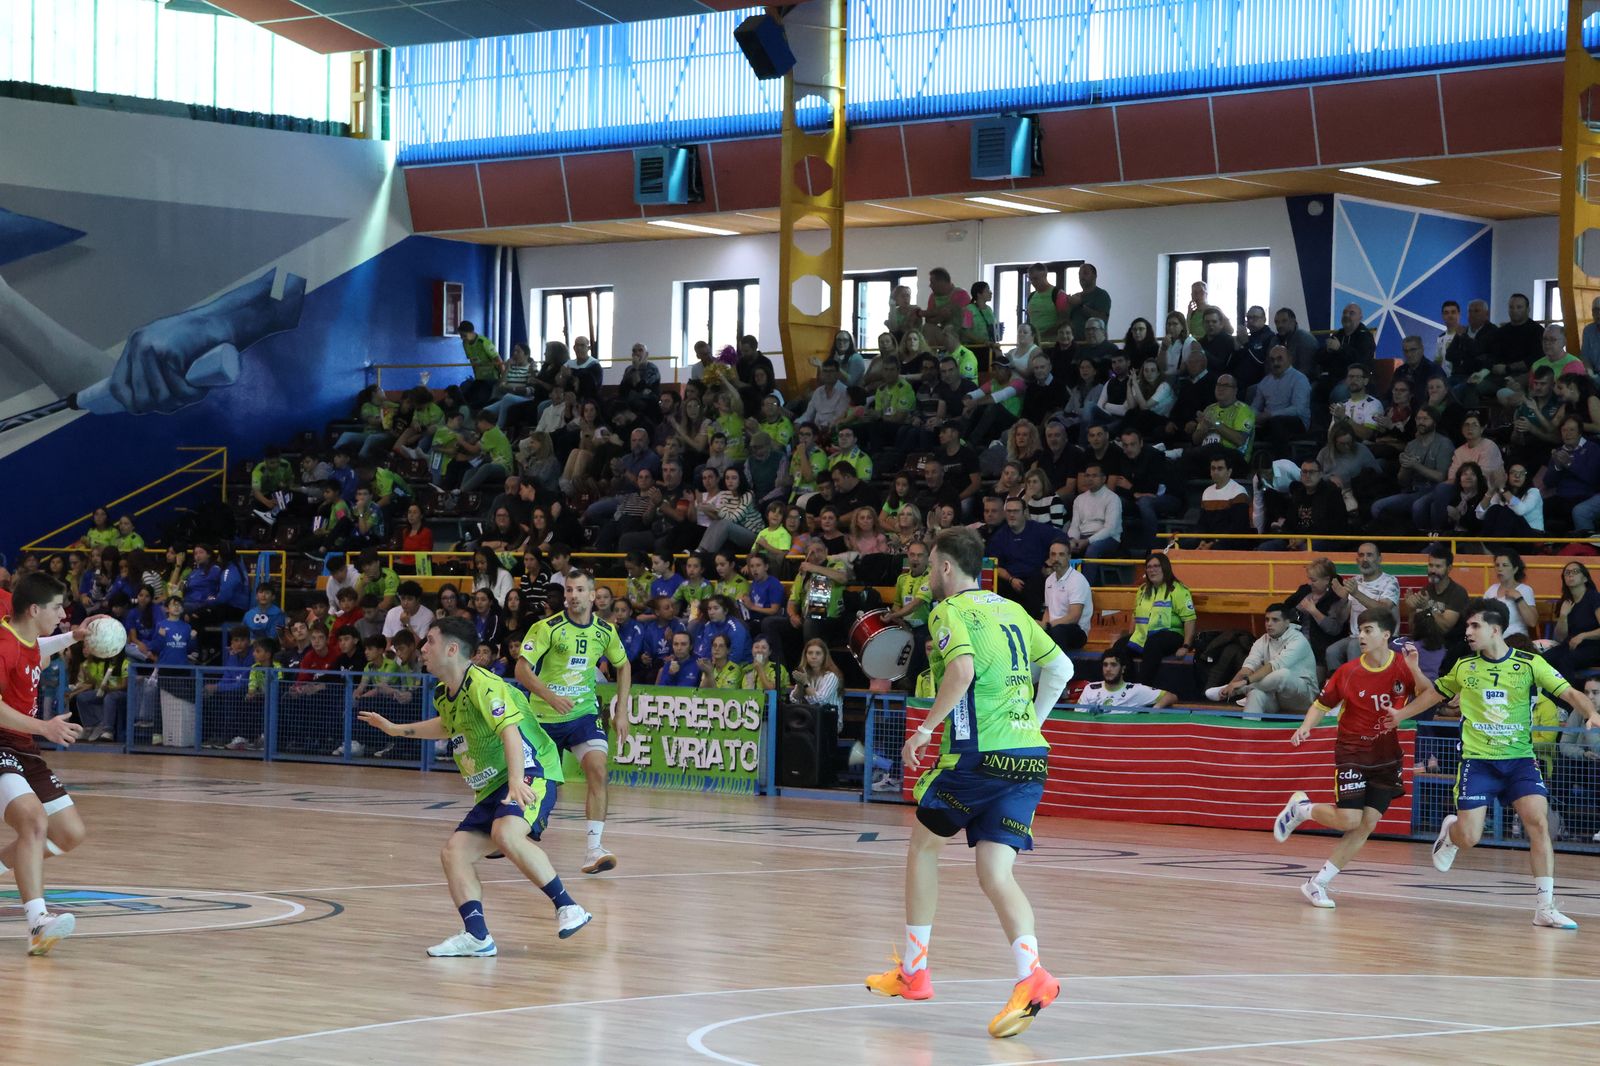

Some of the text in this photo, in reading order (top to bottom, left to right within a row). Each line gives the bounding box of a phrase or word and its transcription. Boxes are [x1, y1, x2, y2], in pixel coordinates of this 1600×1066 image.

[575, 638, 588, 655] 19
[999, 623, 1029, 672] 11
[570, 657, 587, 666] gaza
[1489, 672, 1500, 688] 7
[1370, 693, 1393, 712] 18
[1485, 690, 1505, 700] gaza
[613, 733, 759, 773] DE VIRIATO
